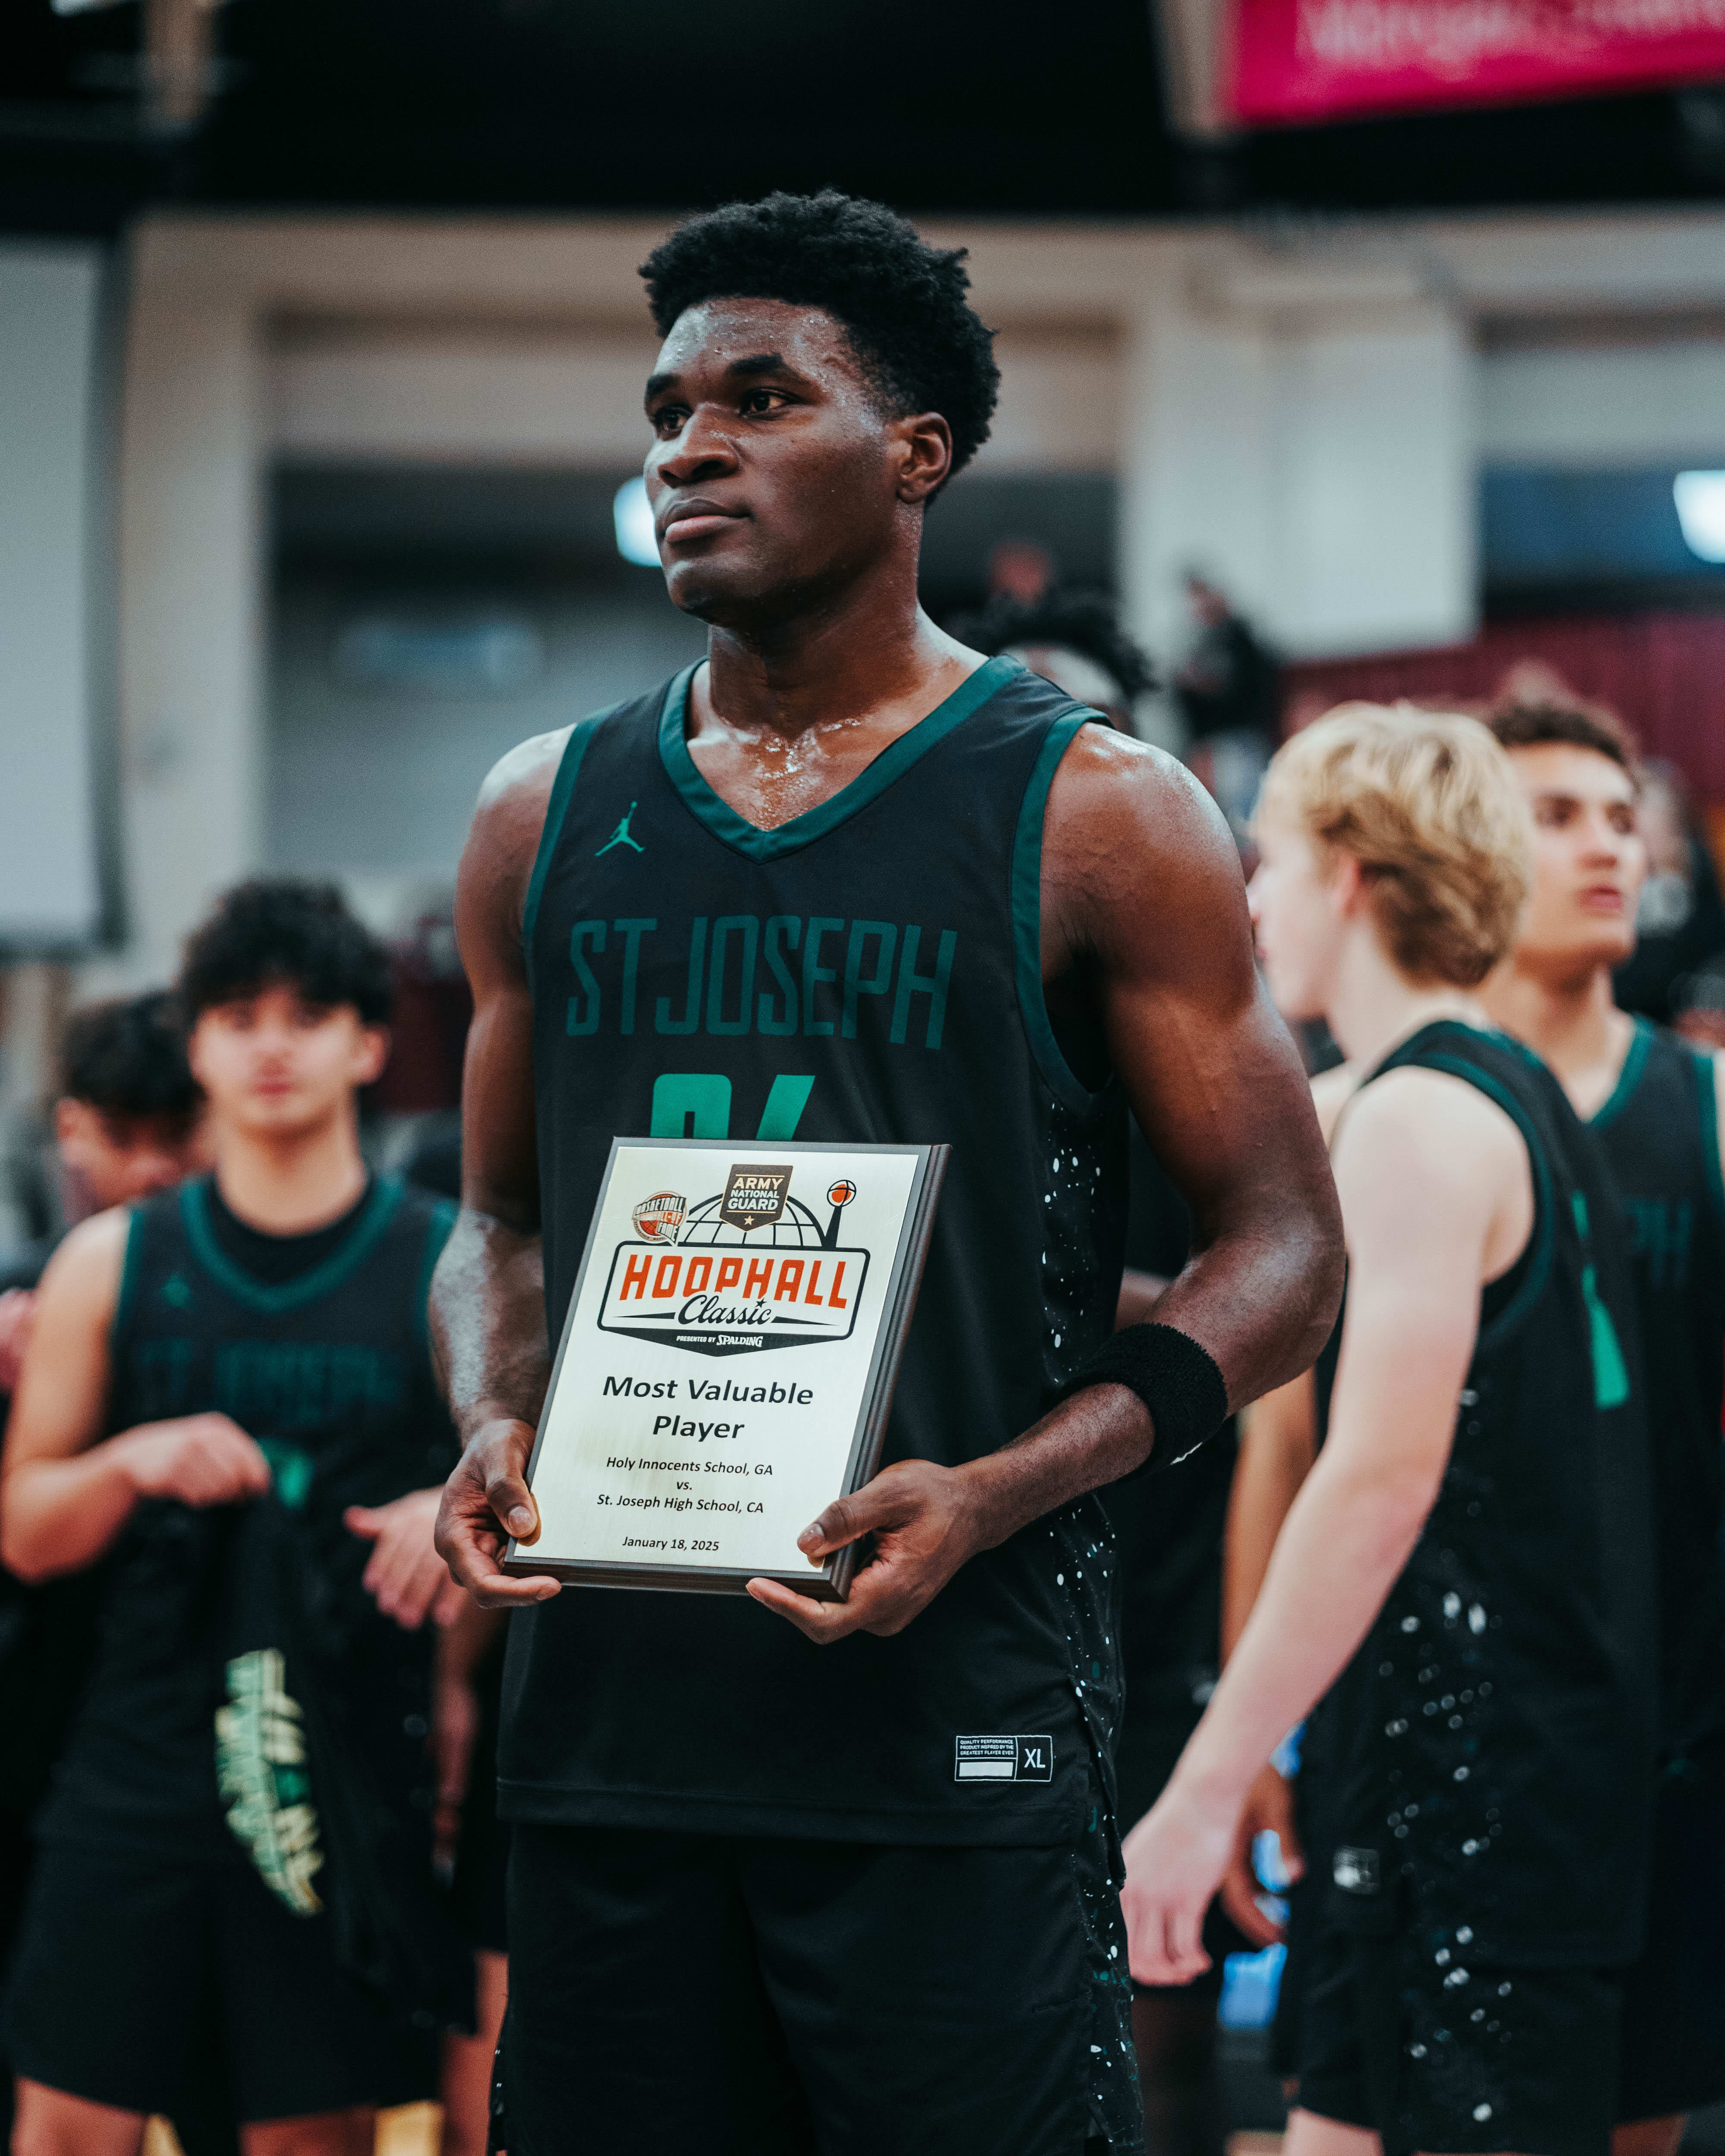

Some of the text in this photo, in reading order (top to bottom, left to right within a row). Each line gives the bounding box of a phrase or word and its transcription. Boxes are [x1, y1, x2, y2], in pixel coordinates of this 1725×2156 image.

[566, 914, 958, 1050] ST JOSEPH
[733, 1177, 784, 1190] ARMY
[730, 1189, 780, 1198] NATIONAL
[635, 1197, 684, 1215] BASKETBALL
[728, 1197, 778, 1210] GUARD
[658, 1222, 679, 1242] FAME
[619, 1254, 847, 1309] HOOPHALL
[677, 1294, 772, 1325] Classic
[716, 1335, 763, 1348] SPALDING
[602, 1376, 814, 1404] Most Valuable
[652, 1415, 745, 1442] Player
[606, 1457, 773, 1476] Holy Innocents School, GA
[677, 1482, 692, 1490] vs.
[597, 1494, 764, 1514] St. Joseph High School, CA
[622, 1536, 719, 1551] January 18, 2025
[1024, 1748, 1046, 1768] XL
